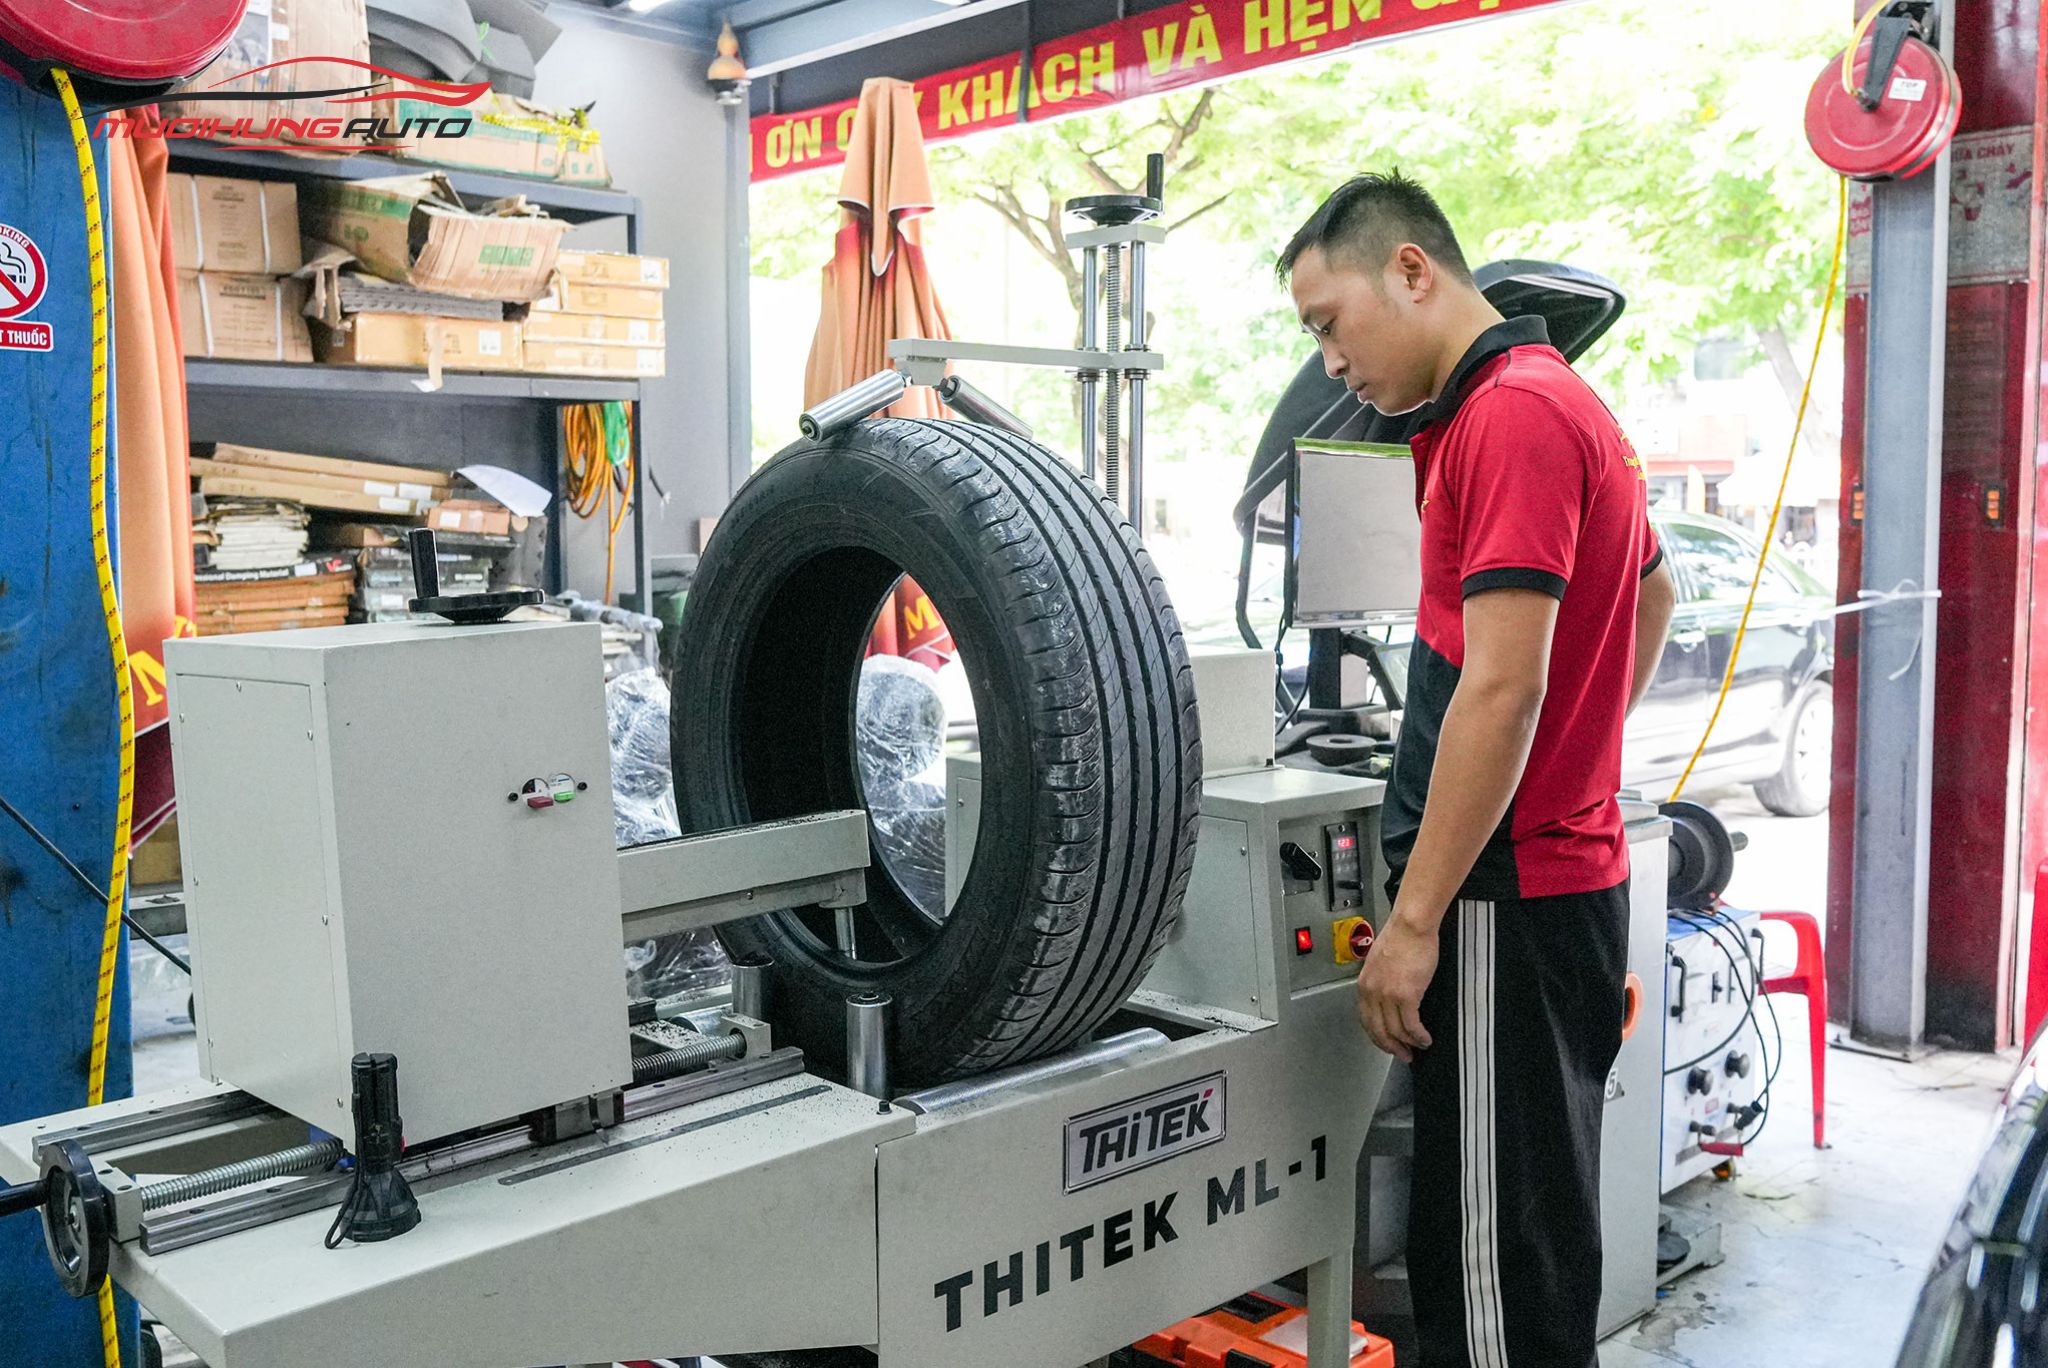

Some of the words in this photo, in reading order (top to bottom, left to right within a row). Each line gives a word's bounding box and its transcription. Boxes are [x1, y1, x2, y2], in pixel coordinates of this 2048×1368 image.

[766, 116, 822, 168] ƠN
[1141, 4, 1223, 77] VÀ
[7, 327, 48, 346] THUỐC
[934, 1191, 1180, 1333] THITEK
[1207, 1135, 1327, 1226] ML-1
